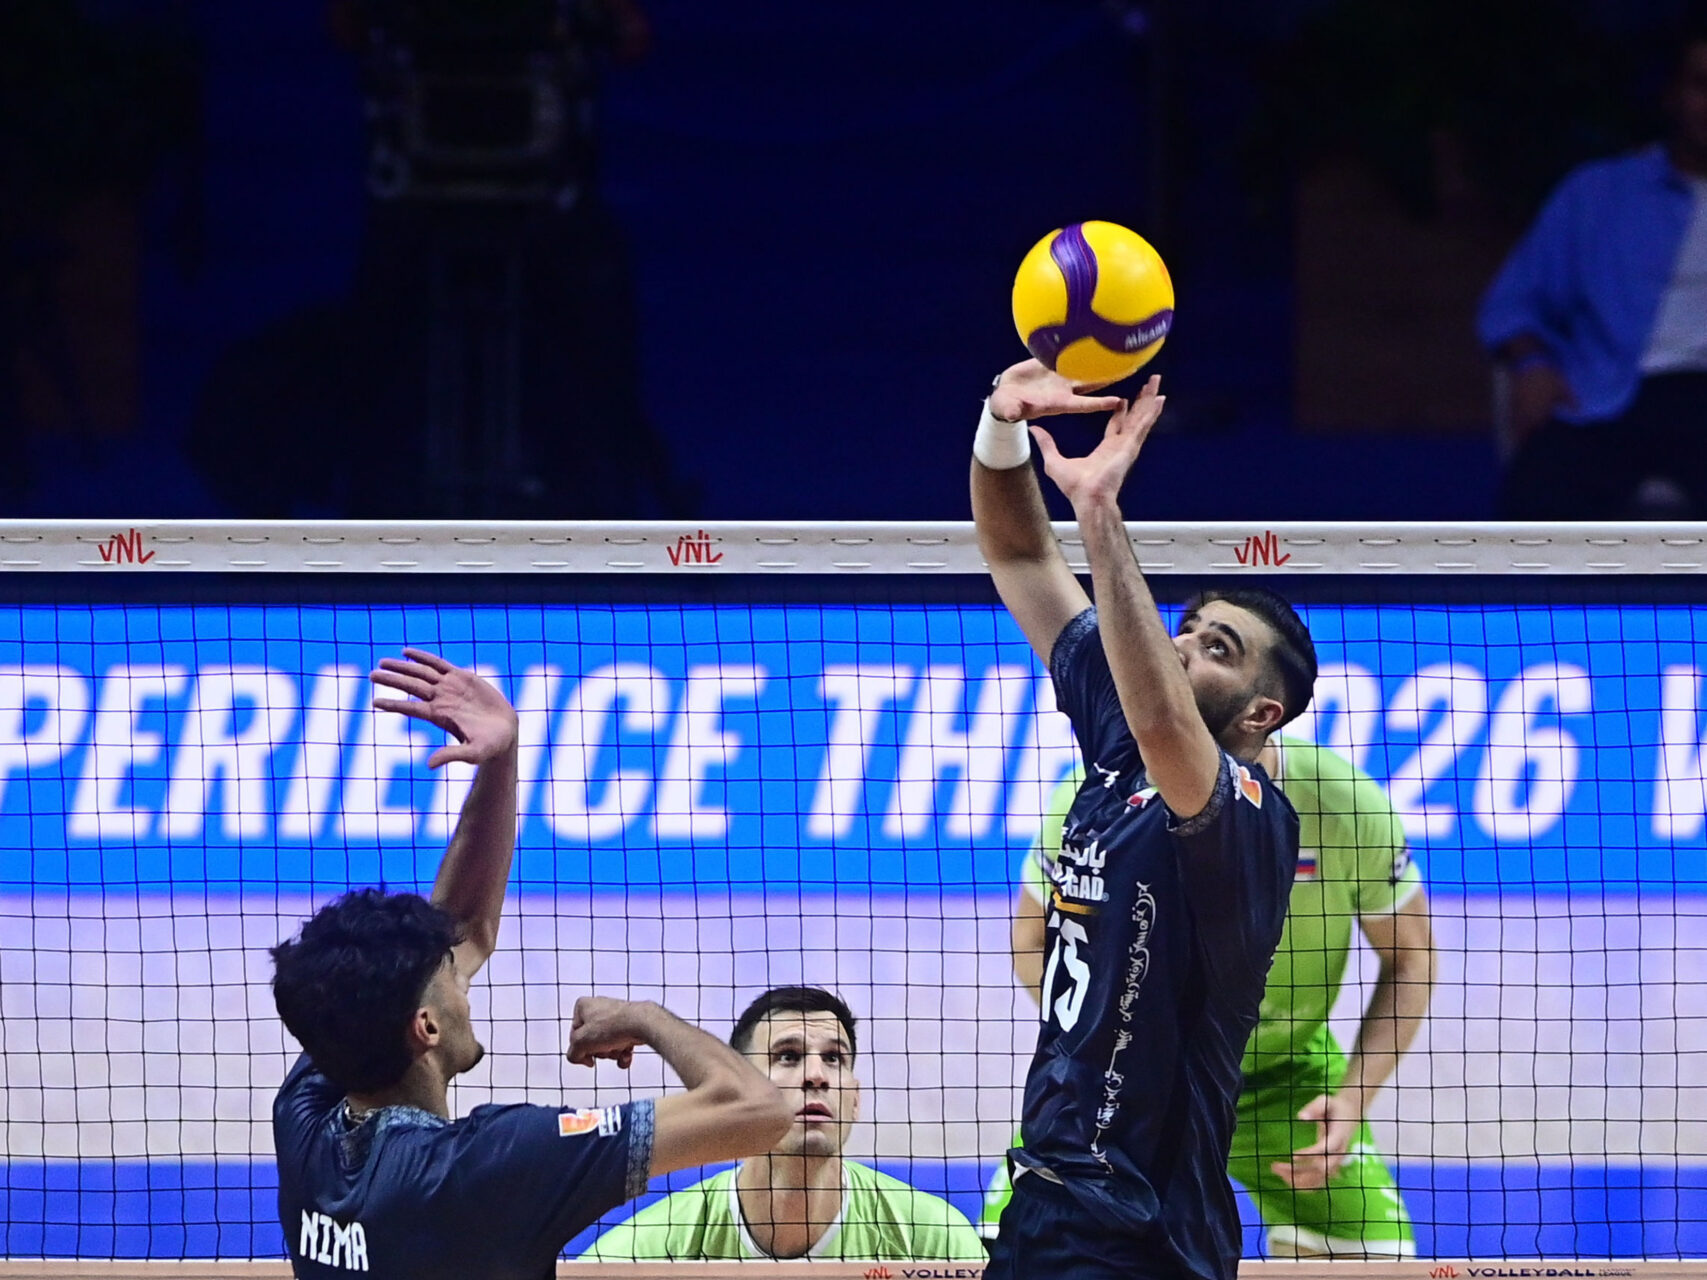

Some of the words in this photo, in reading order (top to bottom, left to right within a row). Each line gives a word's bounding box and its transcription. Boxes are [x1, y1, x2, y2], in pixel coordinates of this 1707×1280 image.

[98, 528, 155, 566] VNL
[667, 529, 724, 566] VNL
[1233, 530, 1291, 568] VNL
[1289, 662, 1592, 841] 026
[1041, 910, 1091, 1033] 15
[300, 1208, 369, 1272] NIMA
[902, 1268, 985, 1278] VOLLEY
[1467, 1268, 1595, 1277] VOLLEYBALL
